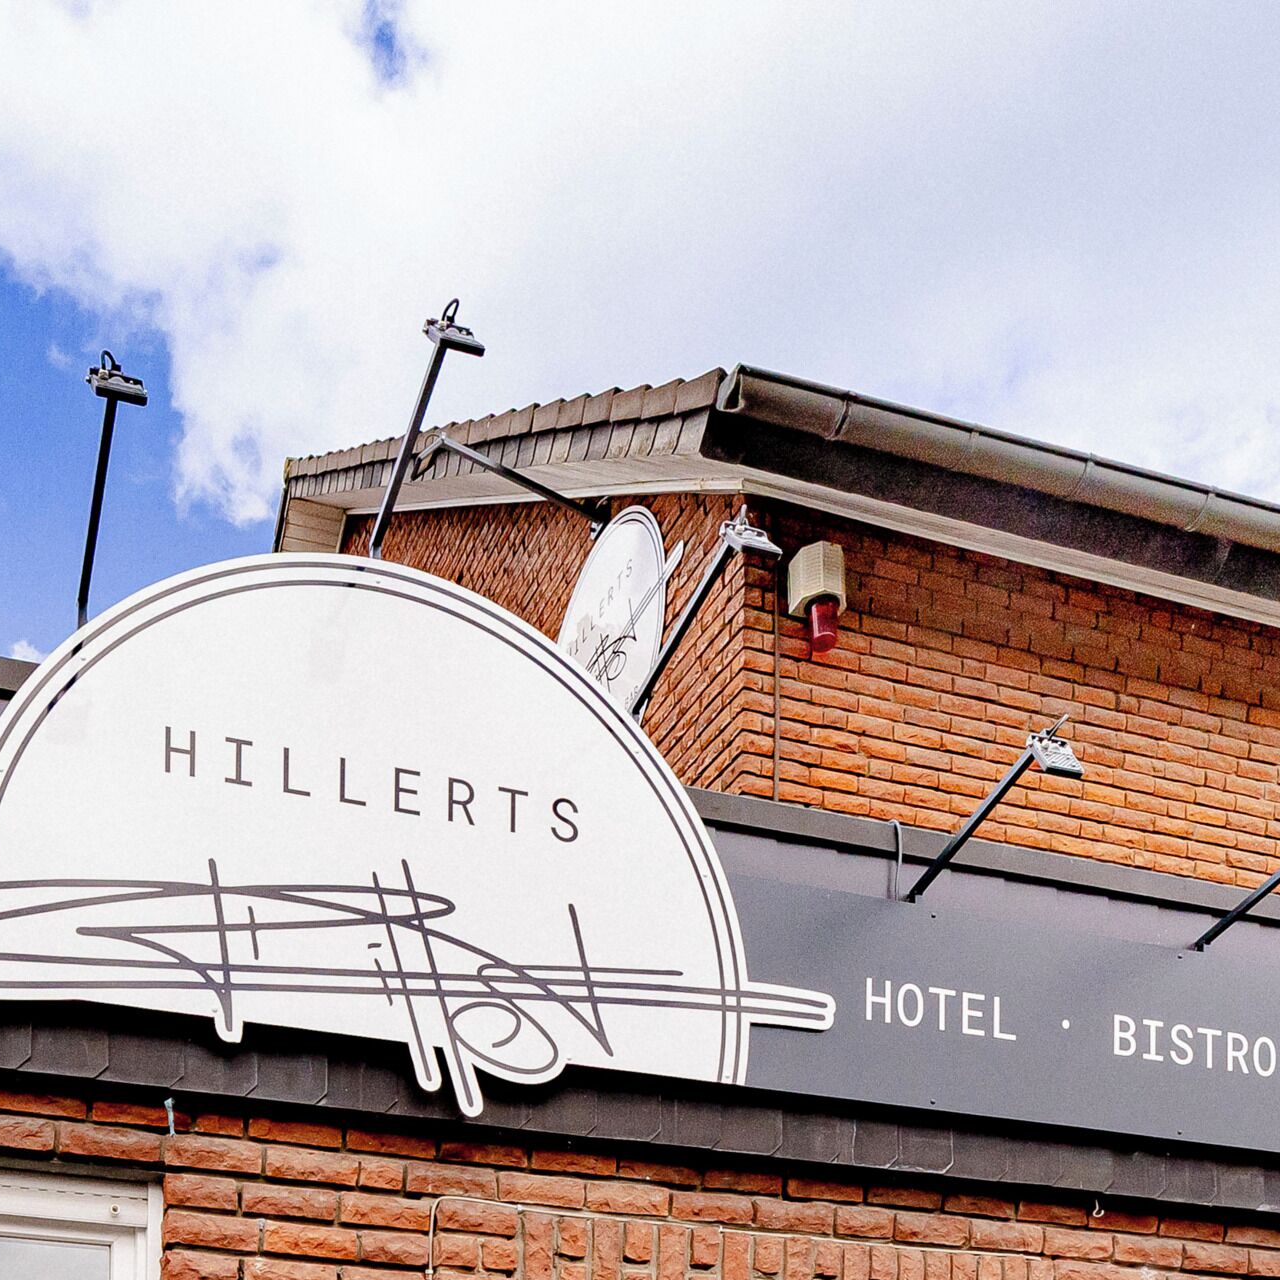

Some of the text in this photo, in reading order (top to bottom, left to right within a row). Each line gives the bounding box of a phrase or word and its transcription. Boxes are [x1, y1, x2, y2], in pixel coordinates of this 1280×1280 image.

[164, 725, 580, 844] HILLERTS
[864, 977, 1018, 1042] HOTEL
[1112, 1013, 1278, 1078] BISTRO
